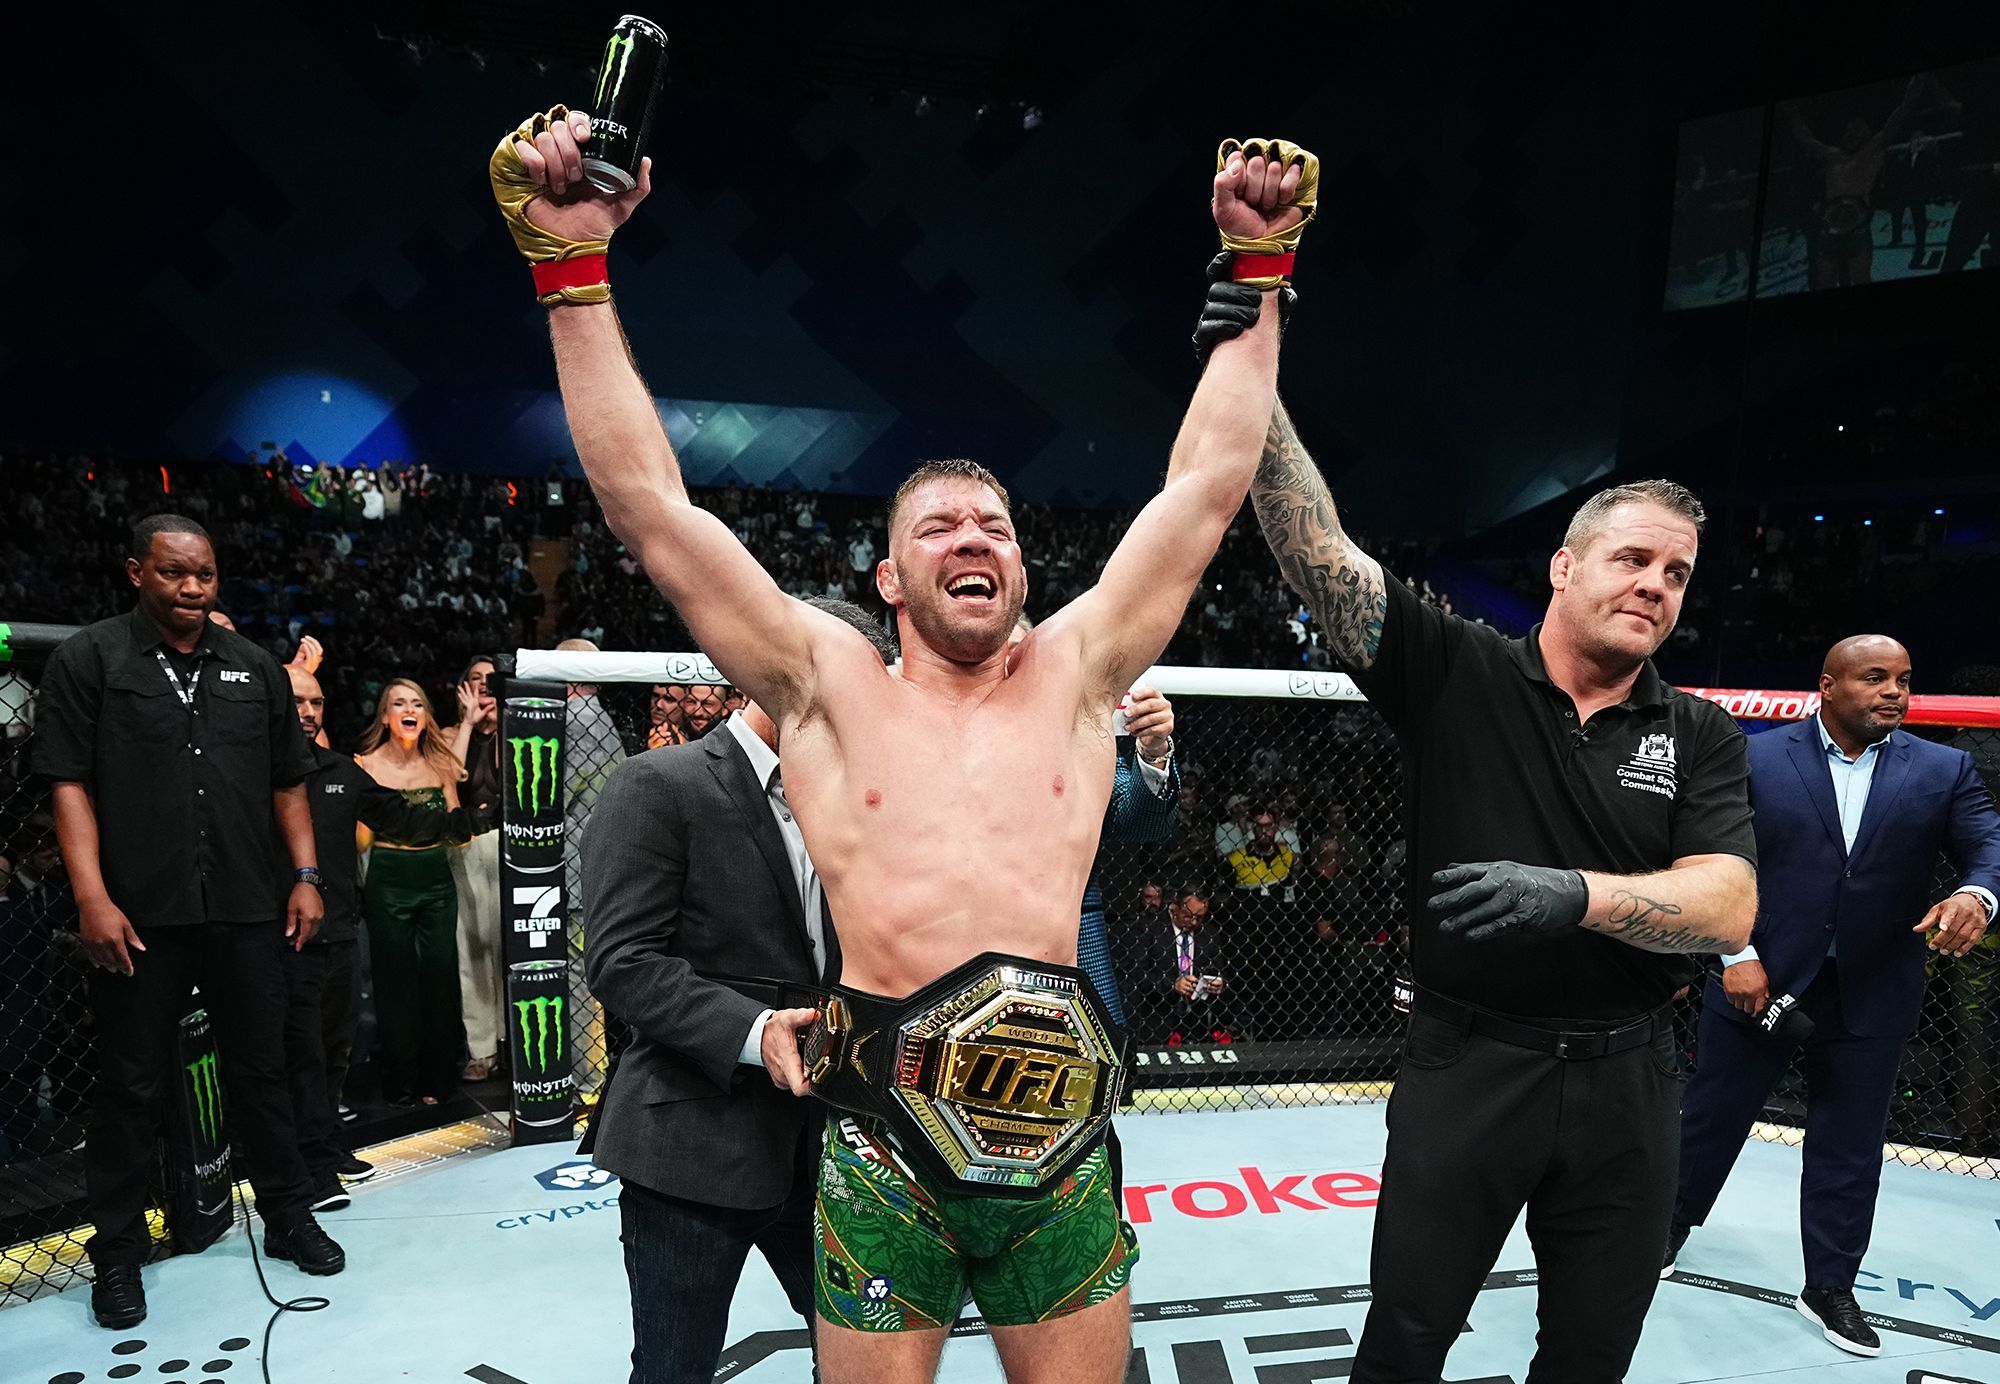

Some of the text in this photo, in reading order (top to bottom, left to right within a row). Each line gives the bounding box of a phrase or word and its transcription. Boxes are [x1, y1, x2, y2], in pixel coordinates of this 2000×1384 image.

[590, 117, 628, 140] STER
[220, 670, 250, 683] UFC
[1616, 768, 1655, 783] Combat
[325, 784, 345, 794] UFC
[510, 838, 561, 848] ENERGY
[1761, 1003, 1782, 1031] UFC
[960, 1049, 1091, 1112] UFC
[520, 1090, 570, 1102] ENERGY
[979, 1117, 1058, 1136] CHAMPION
[1122, 1166, 1383, 1224] roke
